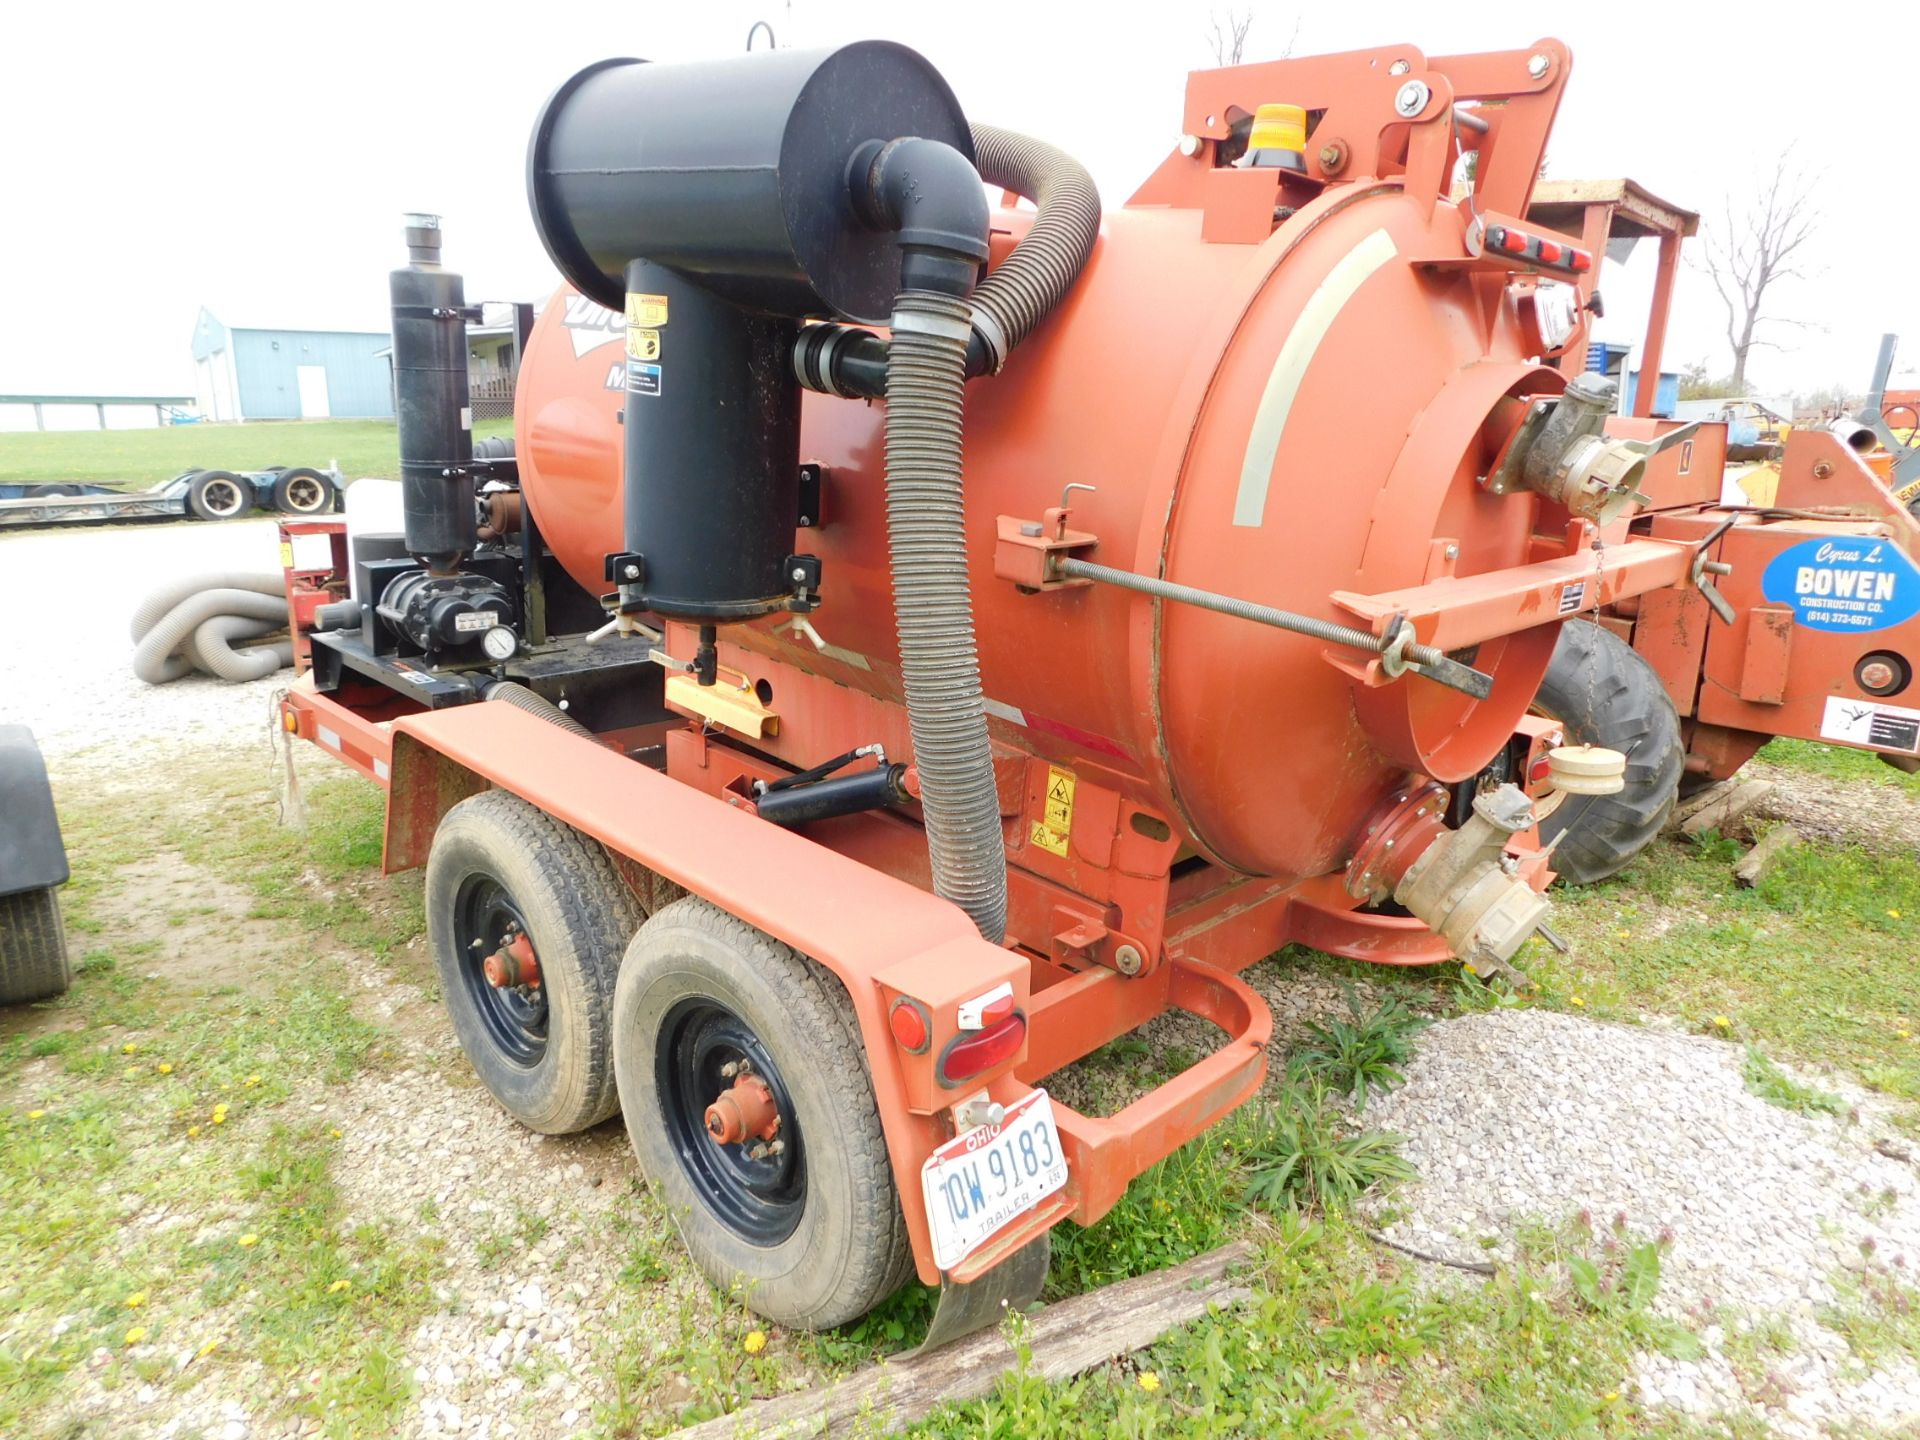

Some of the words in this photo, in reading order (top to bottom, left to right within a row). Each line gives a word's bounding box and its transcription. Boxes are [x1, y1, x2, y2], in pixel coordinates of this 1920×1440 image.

[1816, 543, 1860, 564] Cyrus
[1796, 566, 1895, 600] BOWEN
[1800, 596, 1865, 611] CONSTRUCTION
[1867, 602, 1884, 613] CO.
[1807, 610, 1829, 624] (614)
[966, 1124, 1000, 1151] OHIO
[988, 1121, 1053, 1197] 9183
[979, 1192, 1030, 1233] TRAILER
